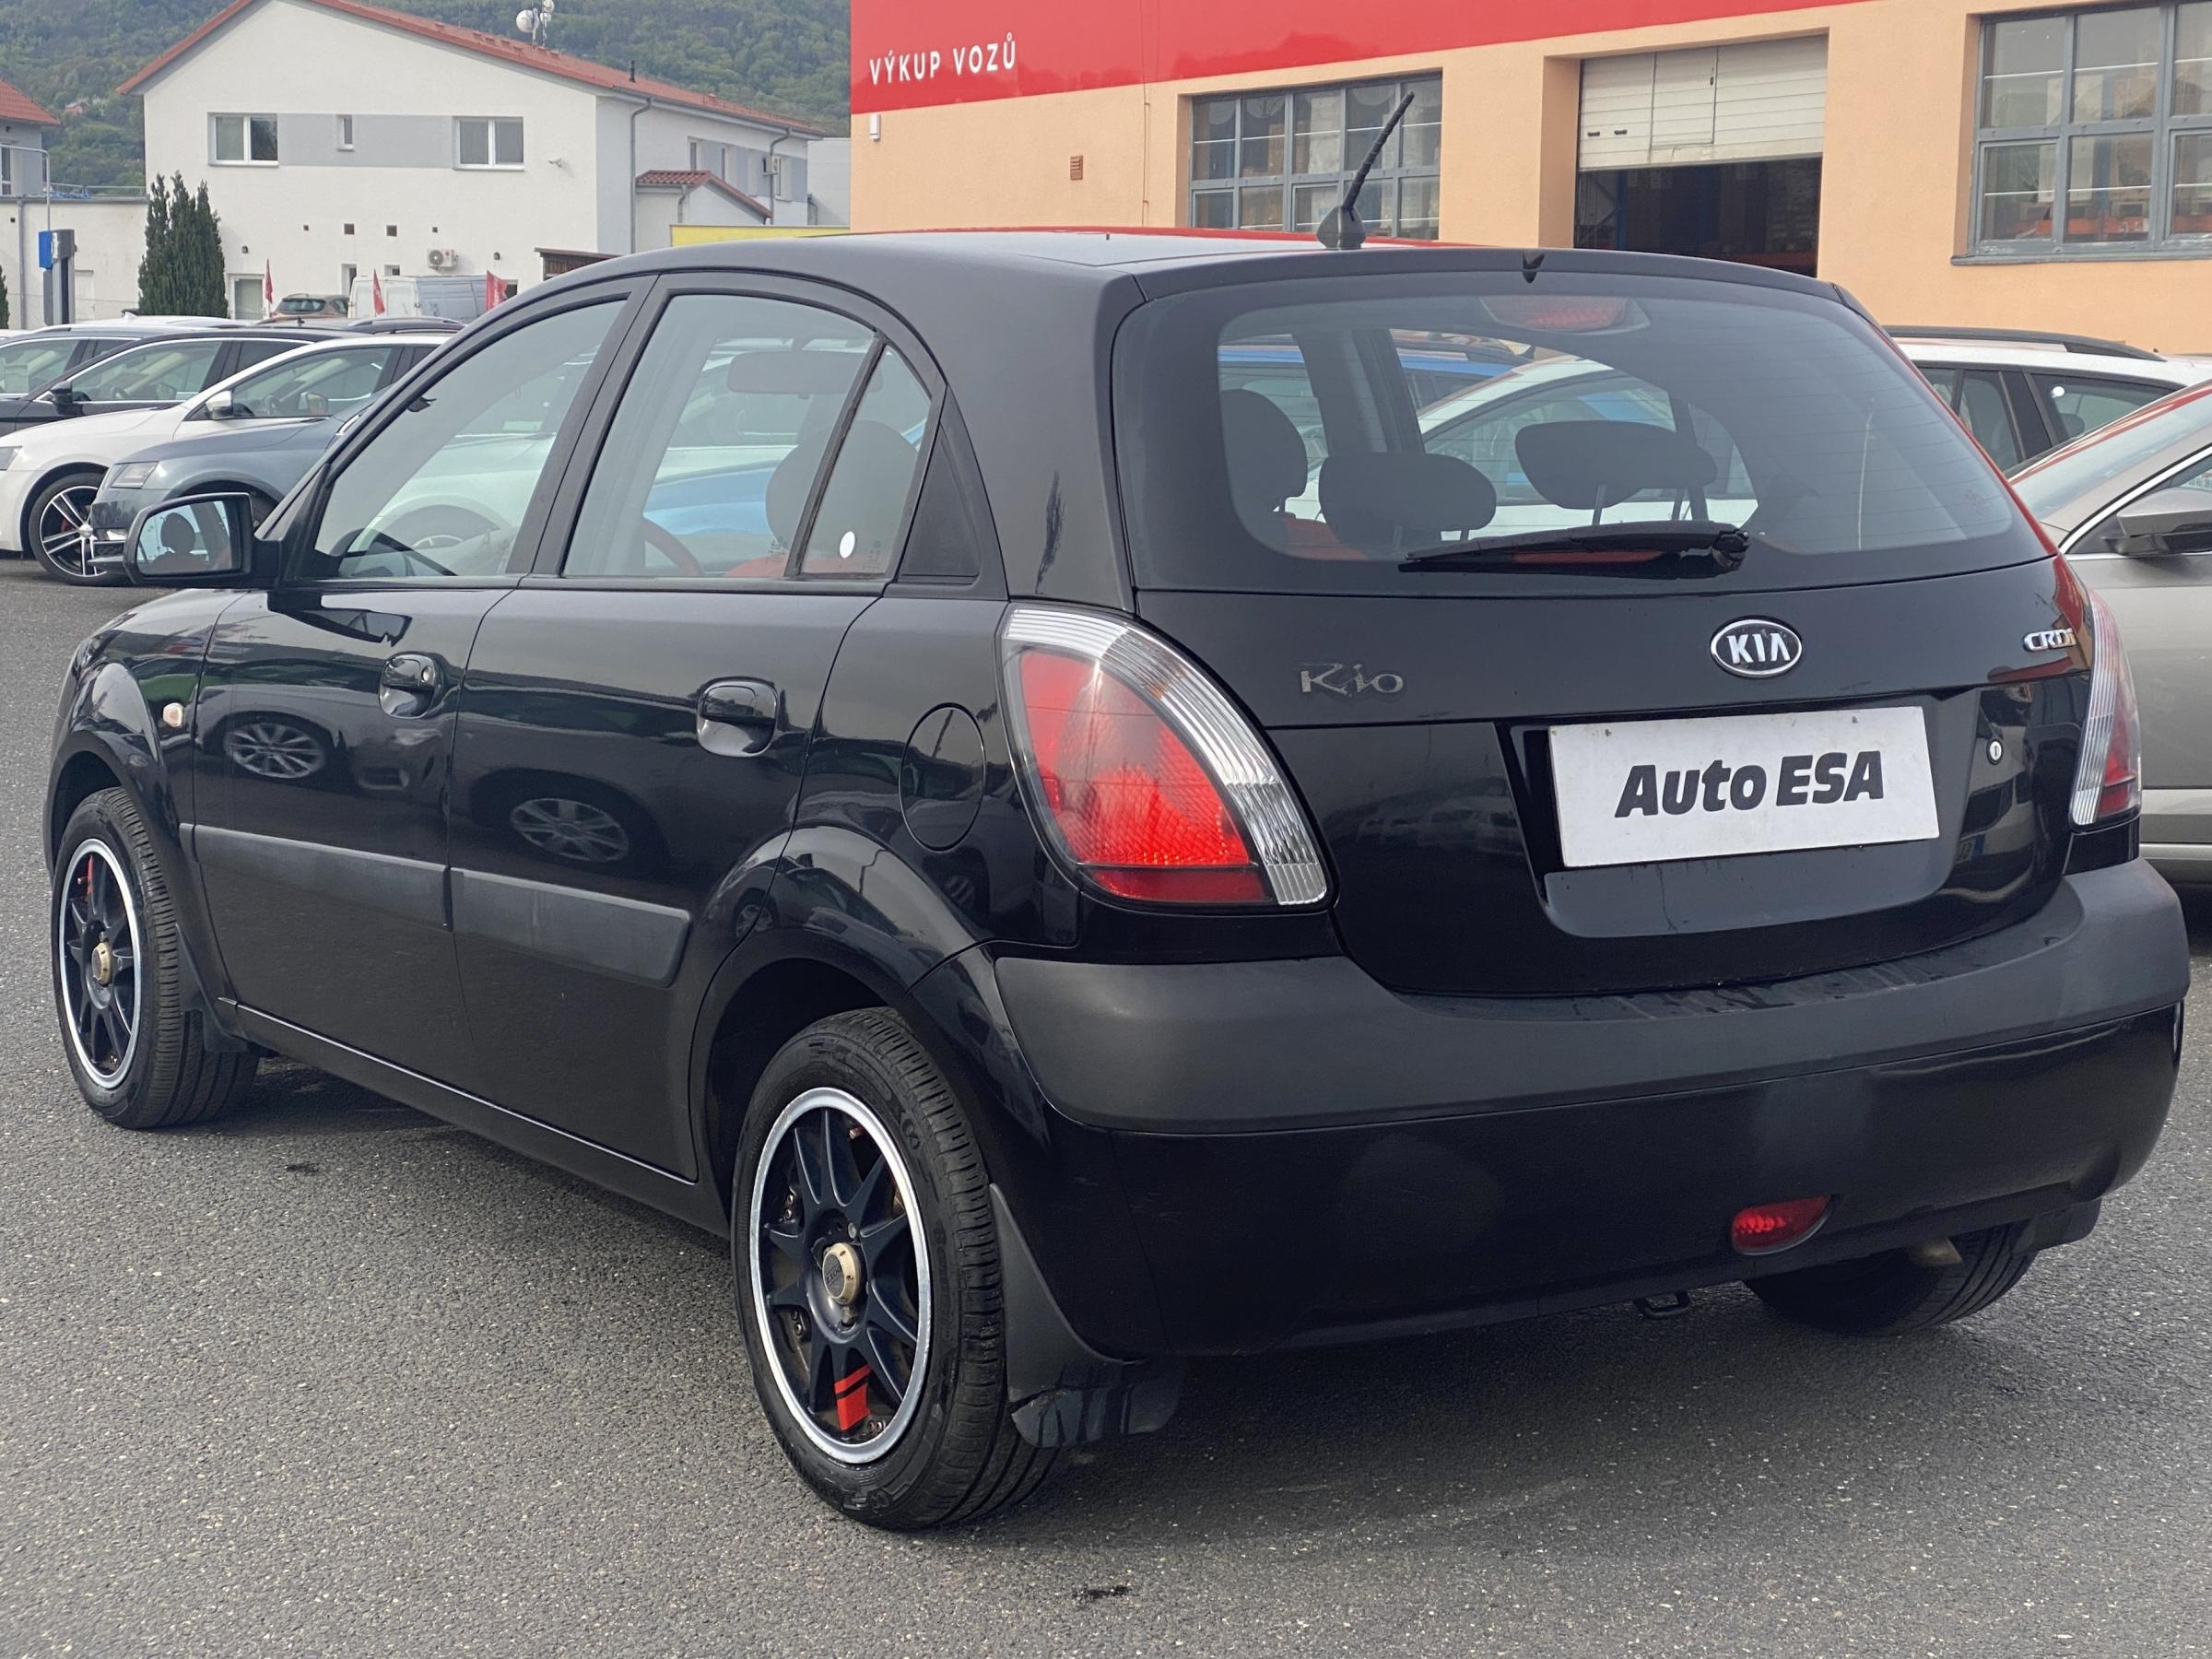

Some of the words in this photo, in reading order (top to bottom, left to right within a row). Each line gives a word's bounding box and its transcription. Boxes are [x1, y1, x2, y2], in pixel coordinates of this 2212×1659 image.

[869, 49, 941, 86] VÝKUP
[952, 31, 1016, 76] VOZŮ
[1726, 632, 1791, 665] KIA
[1614, 759, 1767, 818] Auto
[1775, 750, 1884, 806] ESA
